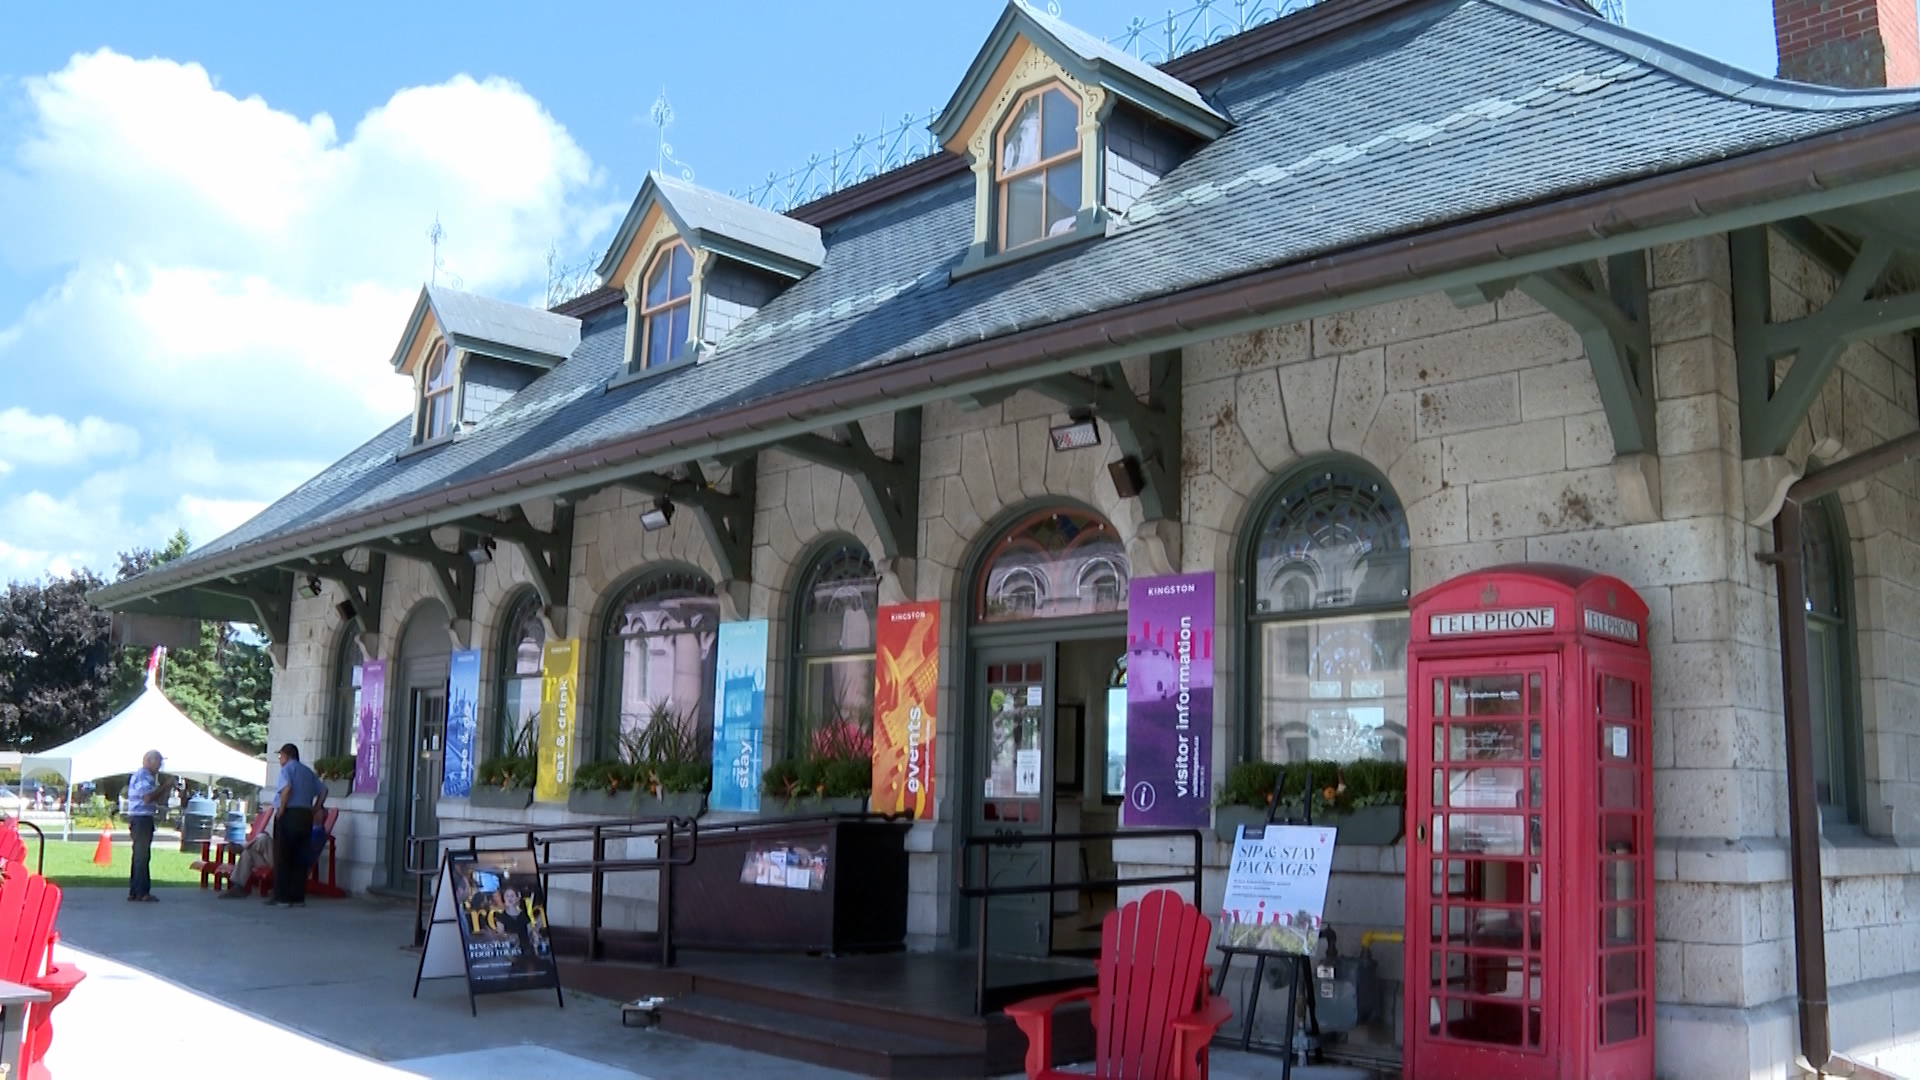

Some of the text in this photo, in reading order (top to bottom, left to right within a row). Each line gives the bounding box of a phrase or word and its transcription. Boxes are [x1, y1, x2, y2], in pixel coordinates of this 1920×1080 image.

[1147, 583, 1196, 596] KINGSTON
[890, 611, 926, 622] KINGSTON
[1435, 608, 1551, 632] TELEPHONE
[1585, 610, 1638, 642] TELEPHONE
[1175, 616, 1191, 797] visitor information
[556, 679, 568, 784] eat & drink
[460, 749, 468, 780] see
[739, 740, 753, 789] stay
[906, 705, 922, 794] events
[1239, 845, 1321, 860] SIP & STAY
[1236, 861, 1319, 877] PACKAGES
